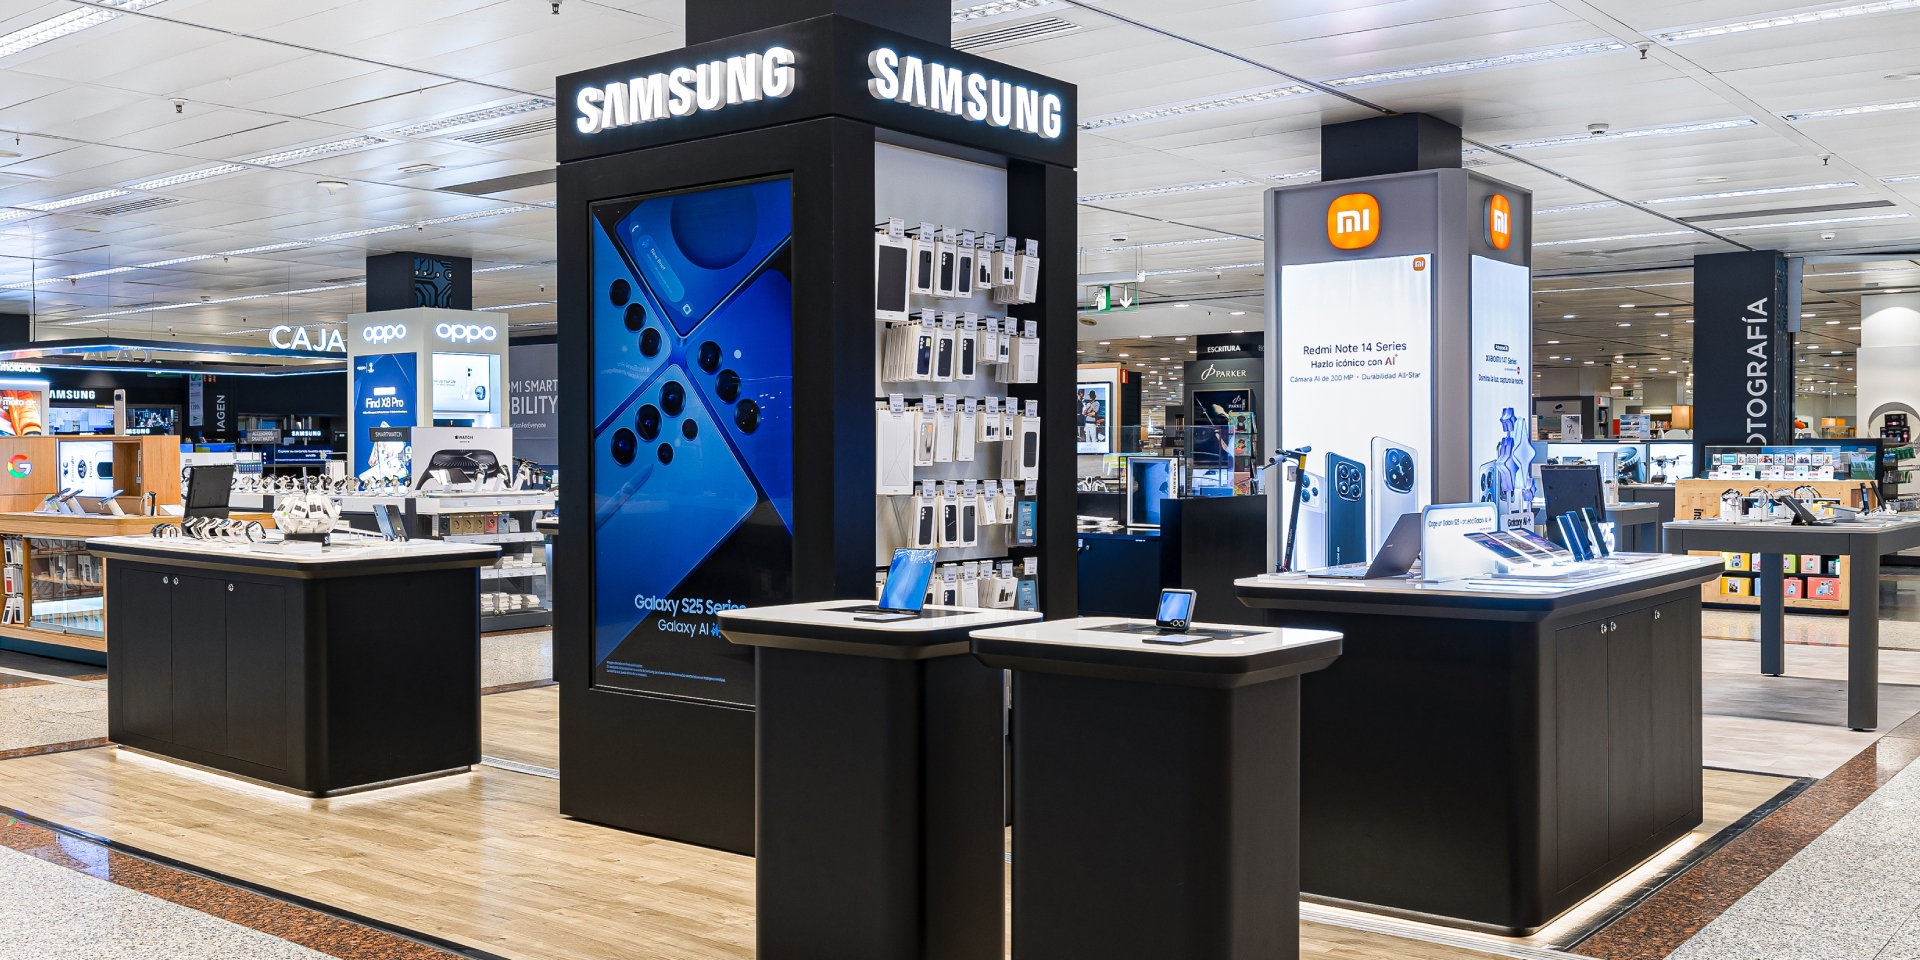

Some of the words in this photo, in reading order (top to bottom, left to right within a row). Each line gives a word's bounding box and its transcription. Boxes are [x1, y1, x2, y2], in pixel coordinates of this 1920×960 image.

[577, 46, 795, 134] SAMSUNG
[868, 47, 1062, 138] SAMSUNG
[269, 325, 346, 352] CAJA
[363, 324, 406, 344] oppo
[436, 323, 497, 343] oppo
[1303, 345, 1332, 355] Redmi
[1335, 344, 1358, 353] Note
[1361, 343, 1372, 352] 14
[1376, 341, 1407, 352] Series
[1310, 360, 1334, 368] Hazlo
[1335, 358, 1365, 367] icónico
[1385, 357, 1395, 365] AI
[1741, 297, 1768, 446] OTOGRAFÍA
[1361, 372, 1396, 380] Durabilidad
[1397, 371, 1421, 379] All-Star
[49, 390, 95, 399] AMSUNG
[508, 381, 522, 393] MI
[525, 379, 558, 392] SMART
[365, 398, 380, 408] Find
[381, 397, 391, 408] X8
[392, 396, 404, 407] Pro
[508, 395, 558, 415] BILITY
[1508, 519, 1522, 528] Galaxy
[635, 594, 679, 617] Galaxy
[682, 598, 703, 614] S25
[658, 619, 696, 638] Galaxy
[699, 623, 709, 635] AI
